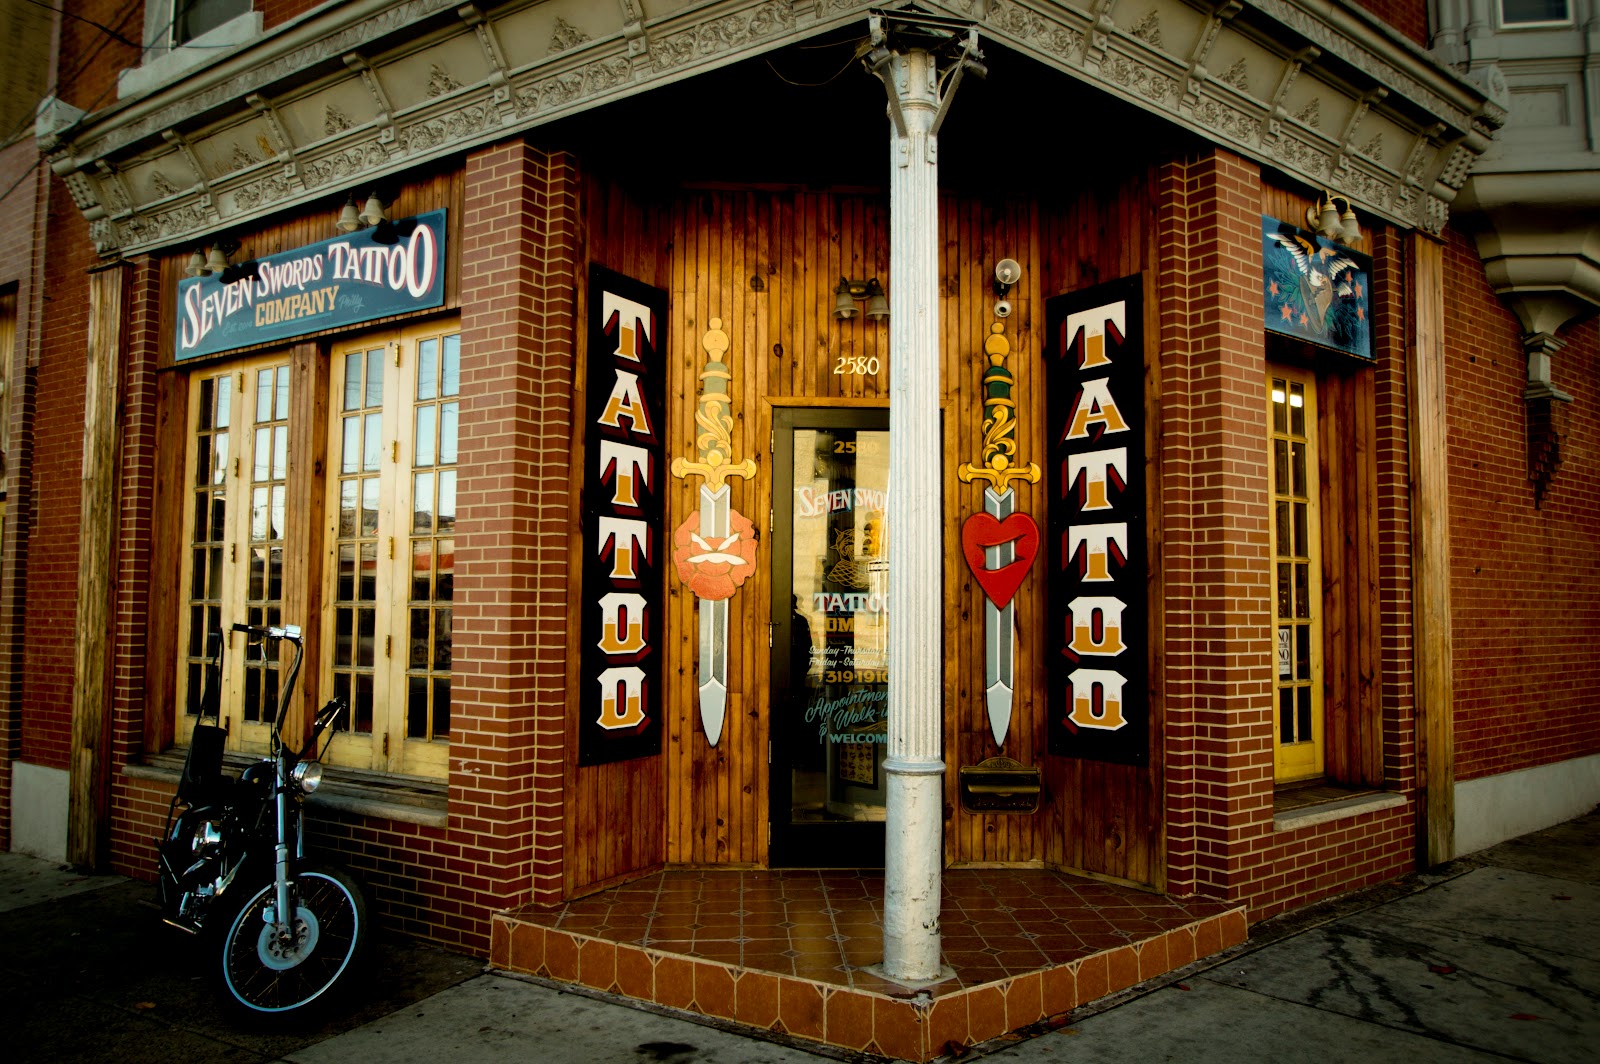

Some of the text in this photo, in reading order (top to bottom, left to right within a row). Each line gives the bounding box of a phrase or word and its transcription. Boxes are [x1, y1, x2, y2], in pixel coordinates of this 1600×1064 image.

[181, 224, 436, 350] SEVEN SWORDS TATTOO
[255, 285, 339, 327] COMPANY
[833, 356, 880, 376] 2580
[596, 290, 653, 731] TATTOO
[799, 487, 852, 516] SEVEN
[1065, 300, 1131, 731] TATTOO
[805, 688, 888, 722] Appointmen
[829, 733, 887, 744] WELCOM
